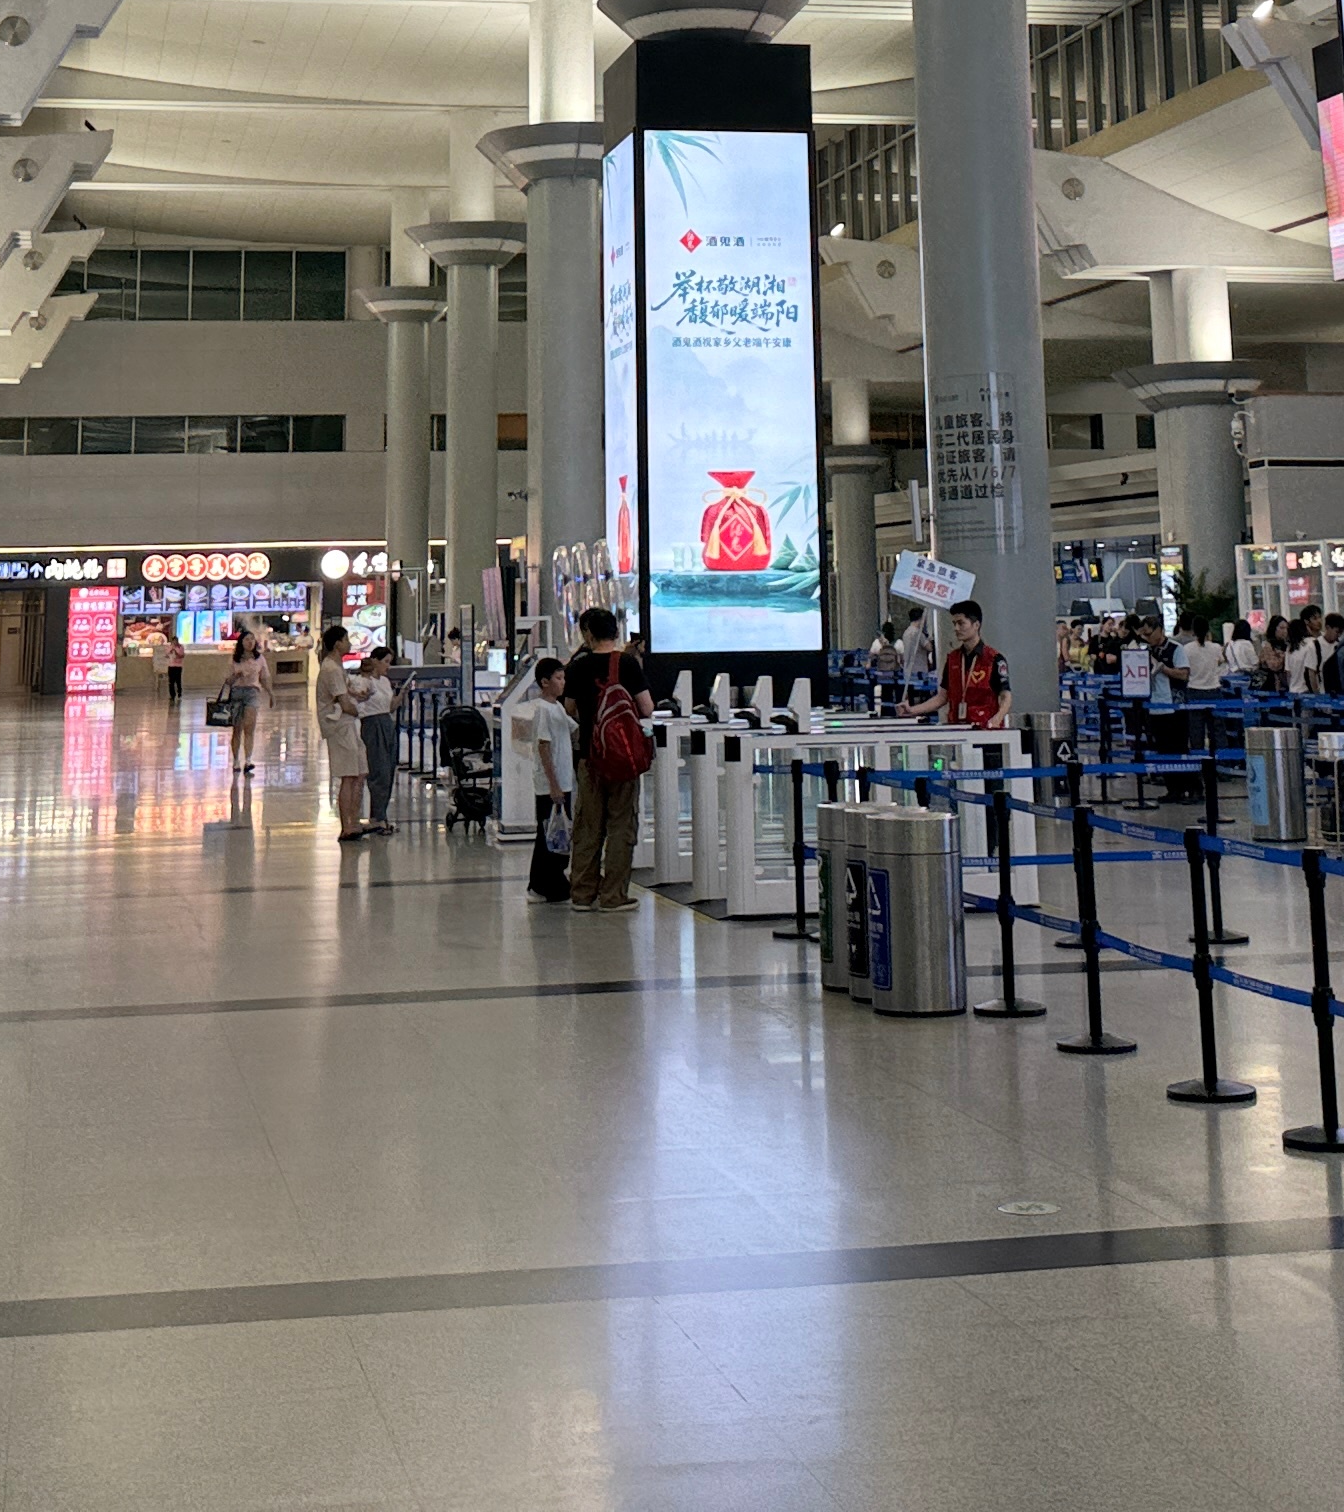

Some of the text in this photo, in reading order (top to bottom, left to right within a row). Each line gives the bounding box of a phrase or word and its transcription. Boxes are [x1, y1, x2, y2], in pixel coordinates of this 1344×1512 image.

[706, 236, 745, 247] 酒鬼酒
[651, 269, 786, 311] 举杯敬湖湘
[672, 336, 792, 348] 酒鬼酒祝家乡父老端午安康
[1124, 666, 1148, 678] 入口
